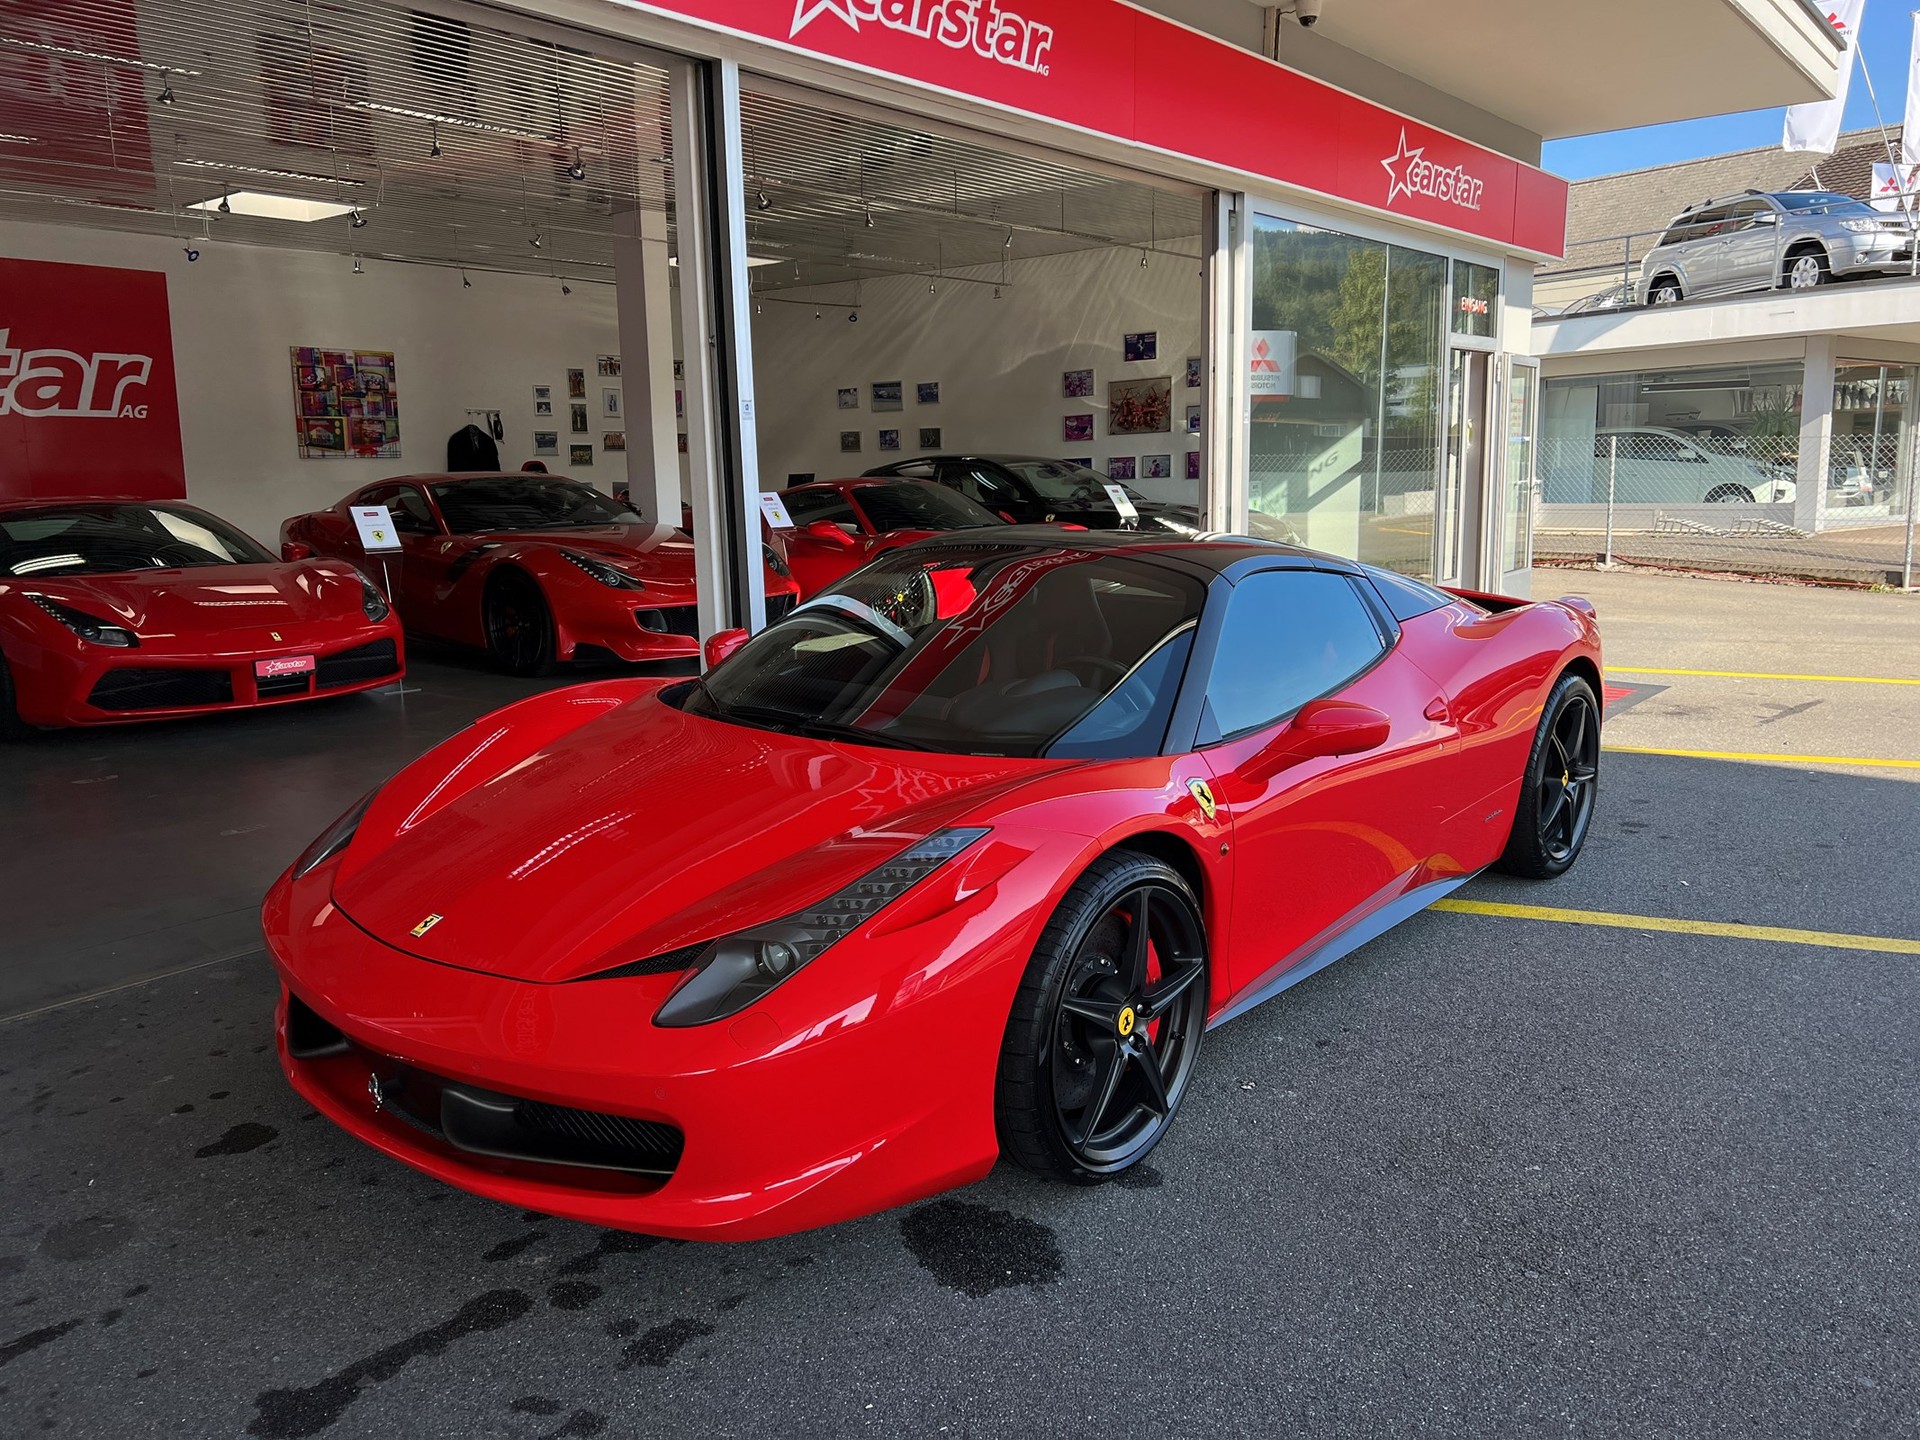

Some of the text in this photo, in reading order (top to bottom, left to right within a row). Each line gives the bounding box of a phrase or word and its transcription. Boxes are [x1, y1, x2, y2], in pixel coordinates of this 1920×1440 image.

[1037, 64, 1050, 76] AG
[1407, 157, 1484, 209] carstar
[119, 404, 149, 419] AG
